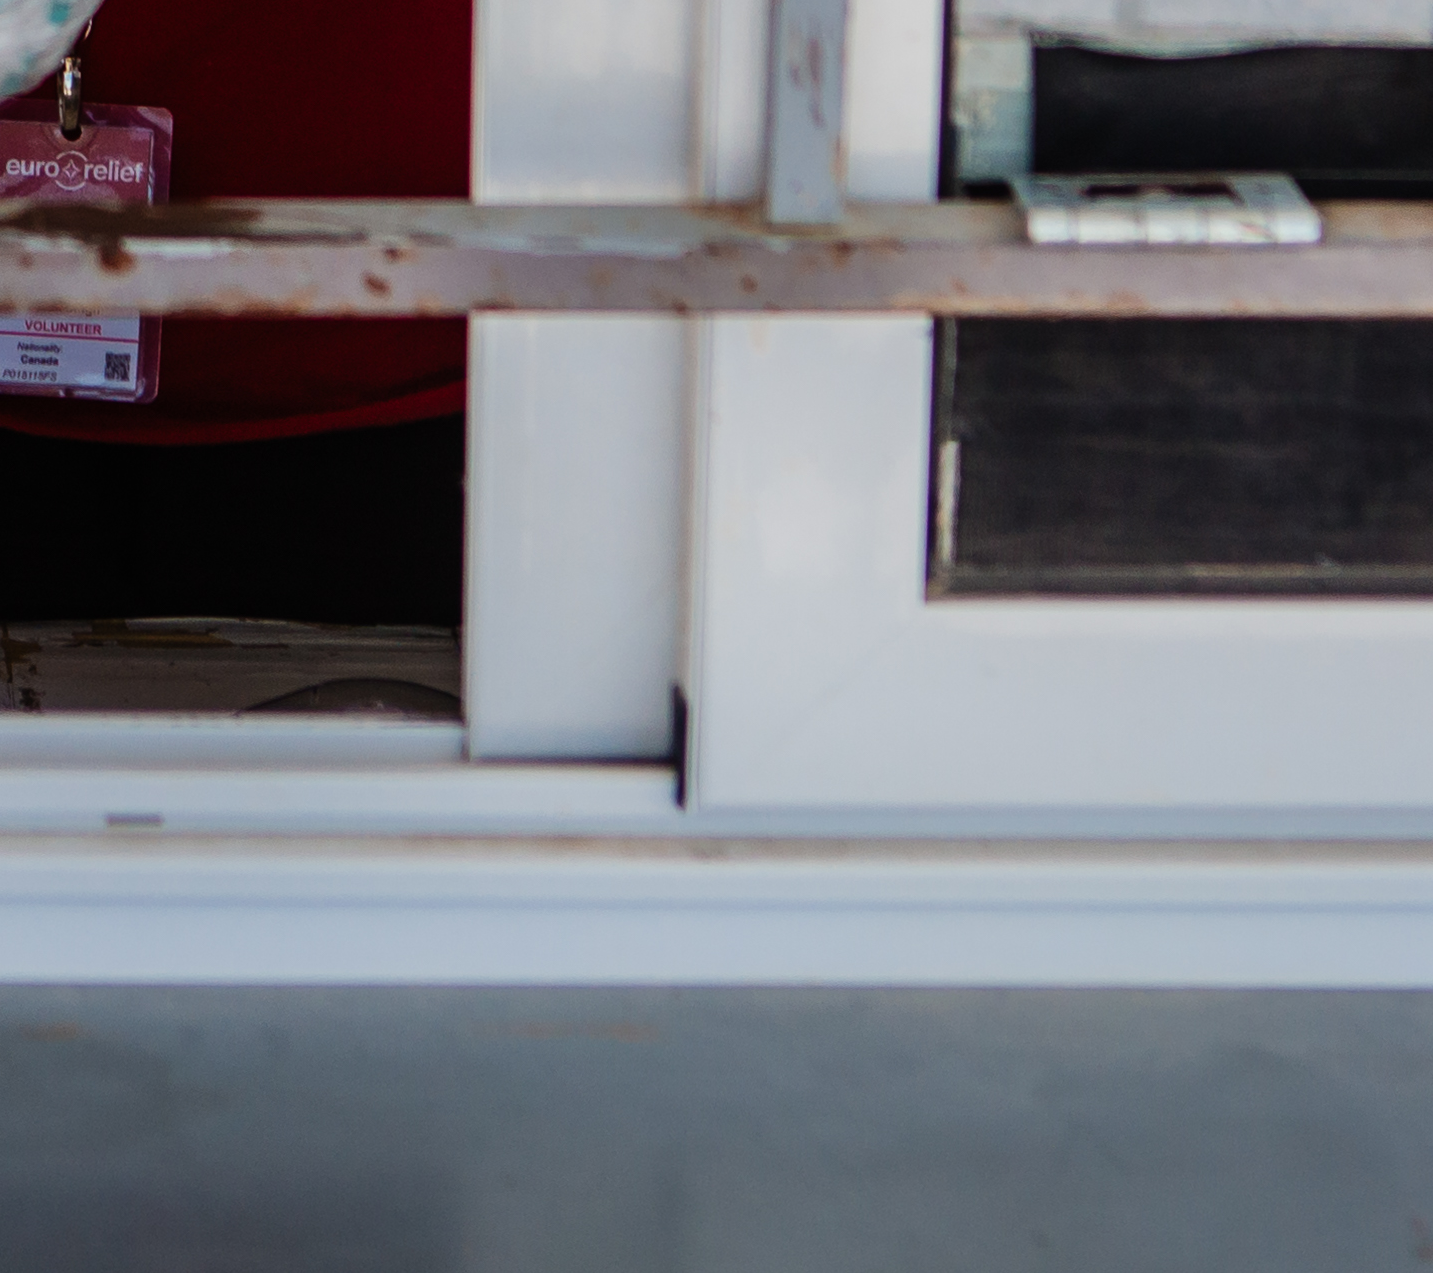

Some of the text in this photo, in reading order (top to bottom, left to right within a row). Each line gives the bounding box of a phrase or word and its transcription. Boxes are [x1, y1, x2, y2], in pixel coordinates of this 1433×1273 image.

[6, 156, 145, 185] euro relief
[25, 319, 102, 336] VOLUNTEER
[20, 354, 59, 366] Canada
